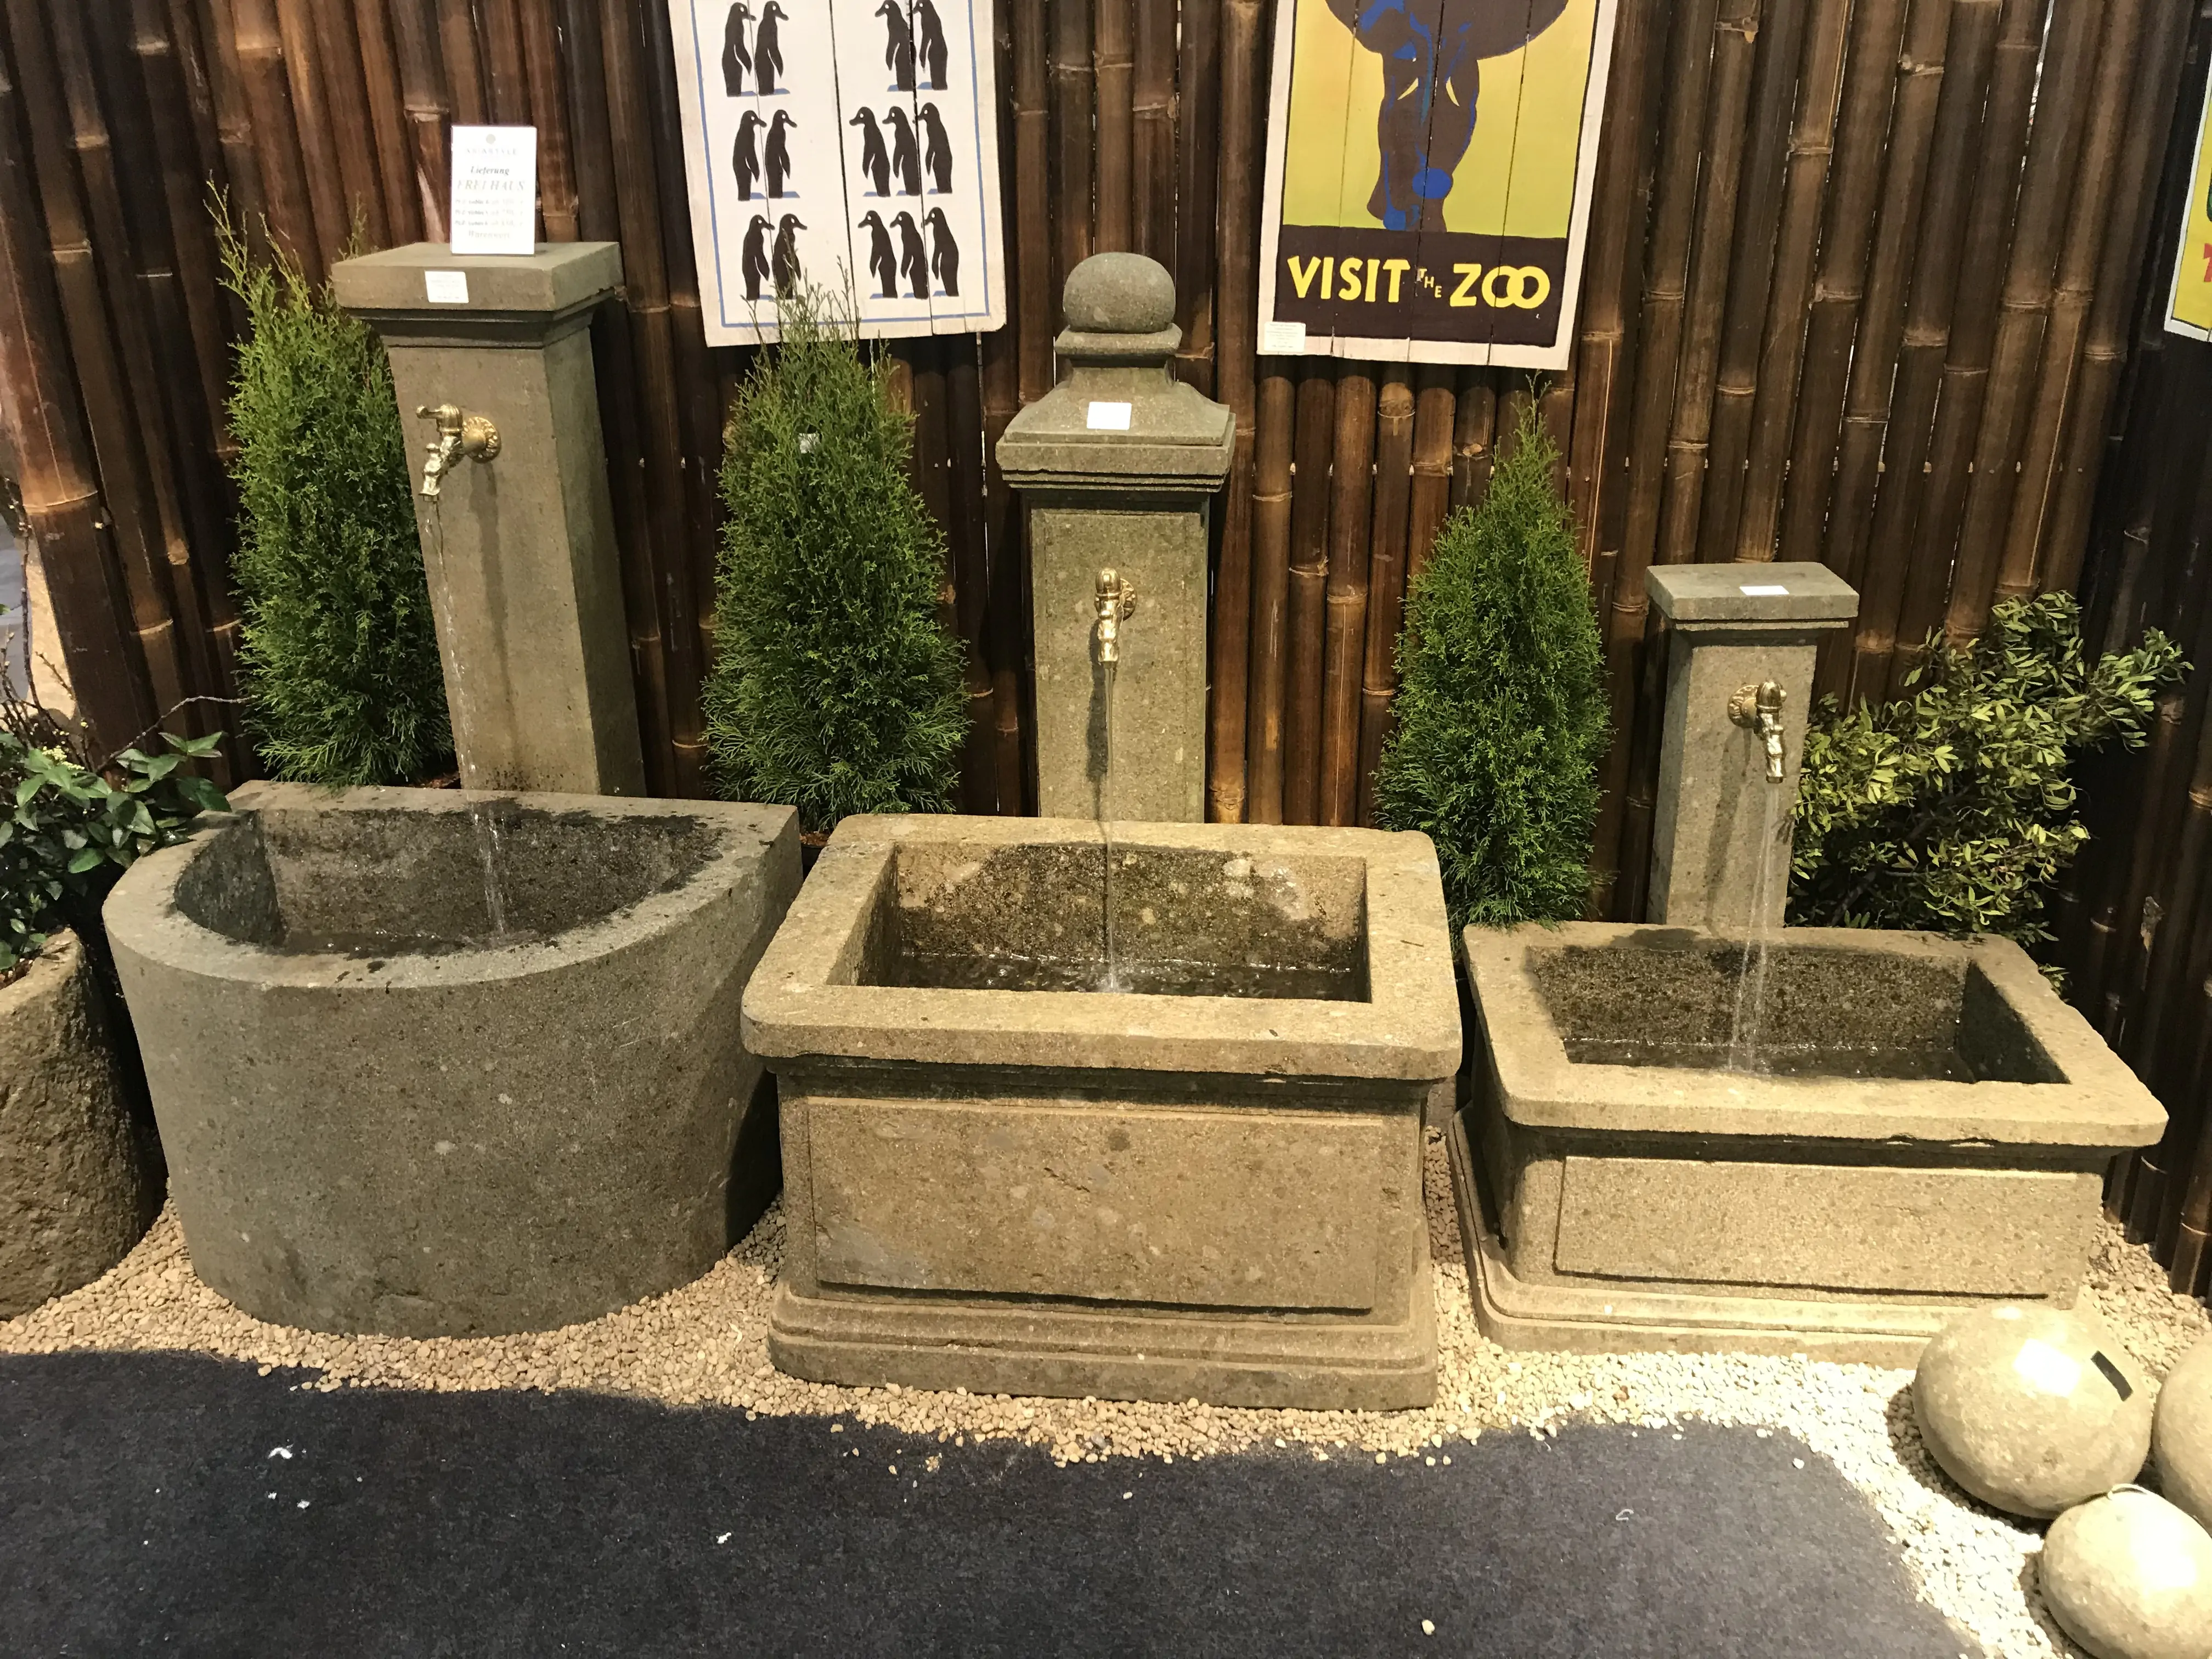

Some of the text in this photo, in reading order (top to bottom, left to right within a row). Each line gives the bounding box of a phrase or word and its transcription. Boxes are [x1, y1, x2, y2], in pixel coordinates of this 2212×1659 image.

[471, 165, 510, 176] Lieferung
[1287, 255, 1550, 309] VISIT THE ZOO
